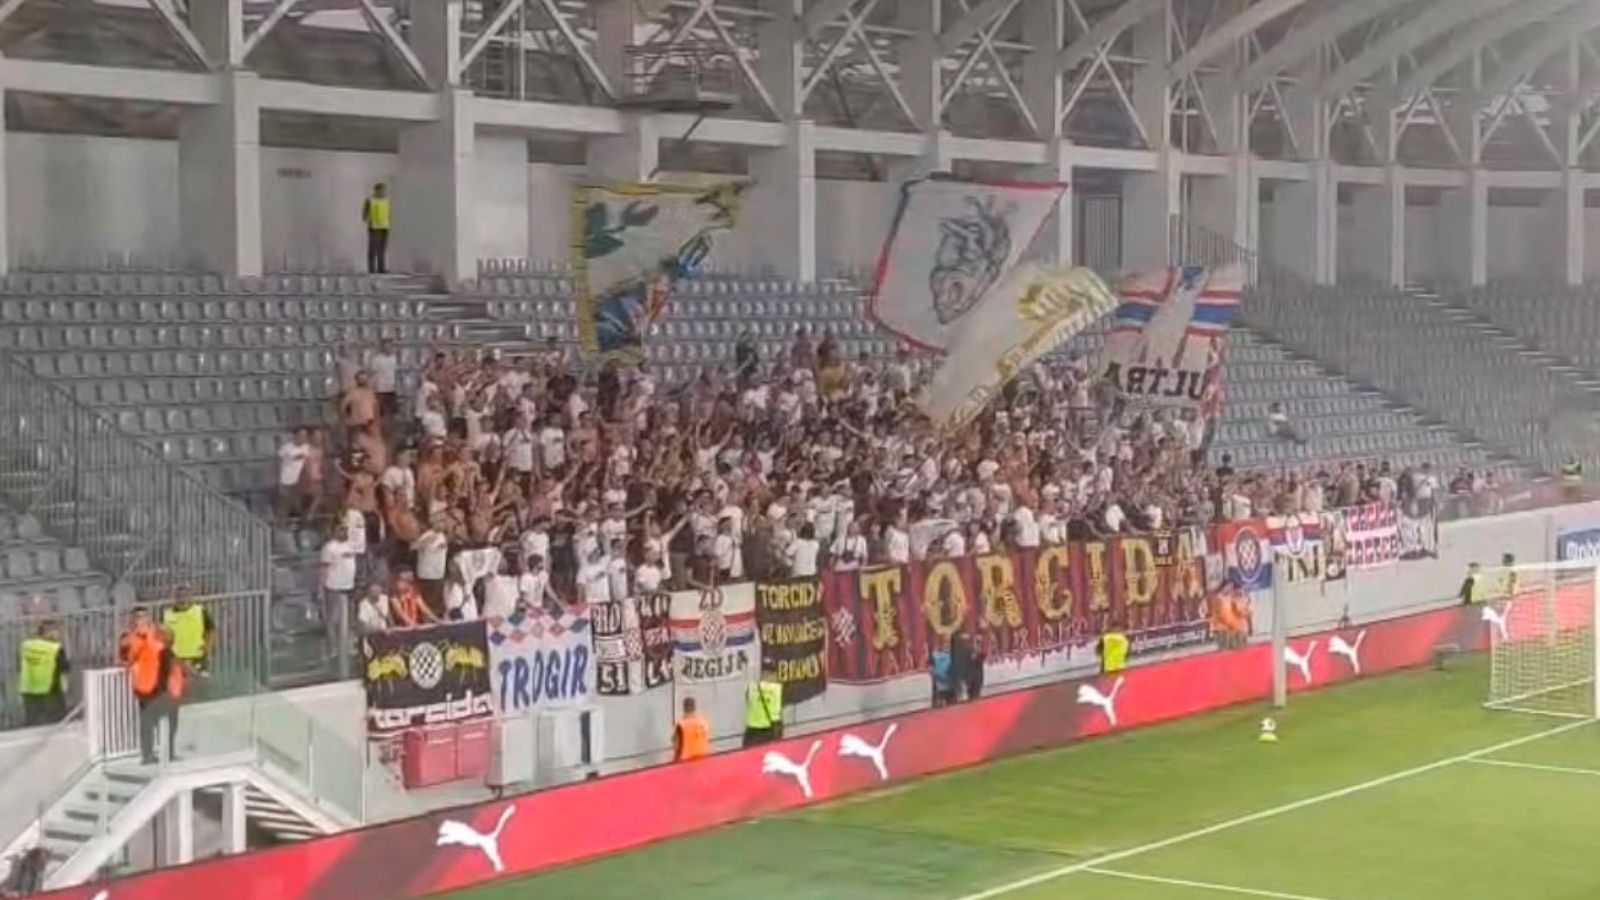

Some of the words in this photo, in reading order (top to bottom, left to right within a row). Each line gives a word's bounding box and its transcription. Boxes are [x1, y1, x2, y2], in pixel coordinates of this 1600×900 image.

[860, 533, 1204, 650] TORCIDA
[369, 689, 494, 729] torcida
[498, 643, 588, 712] TROGIR
